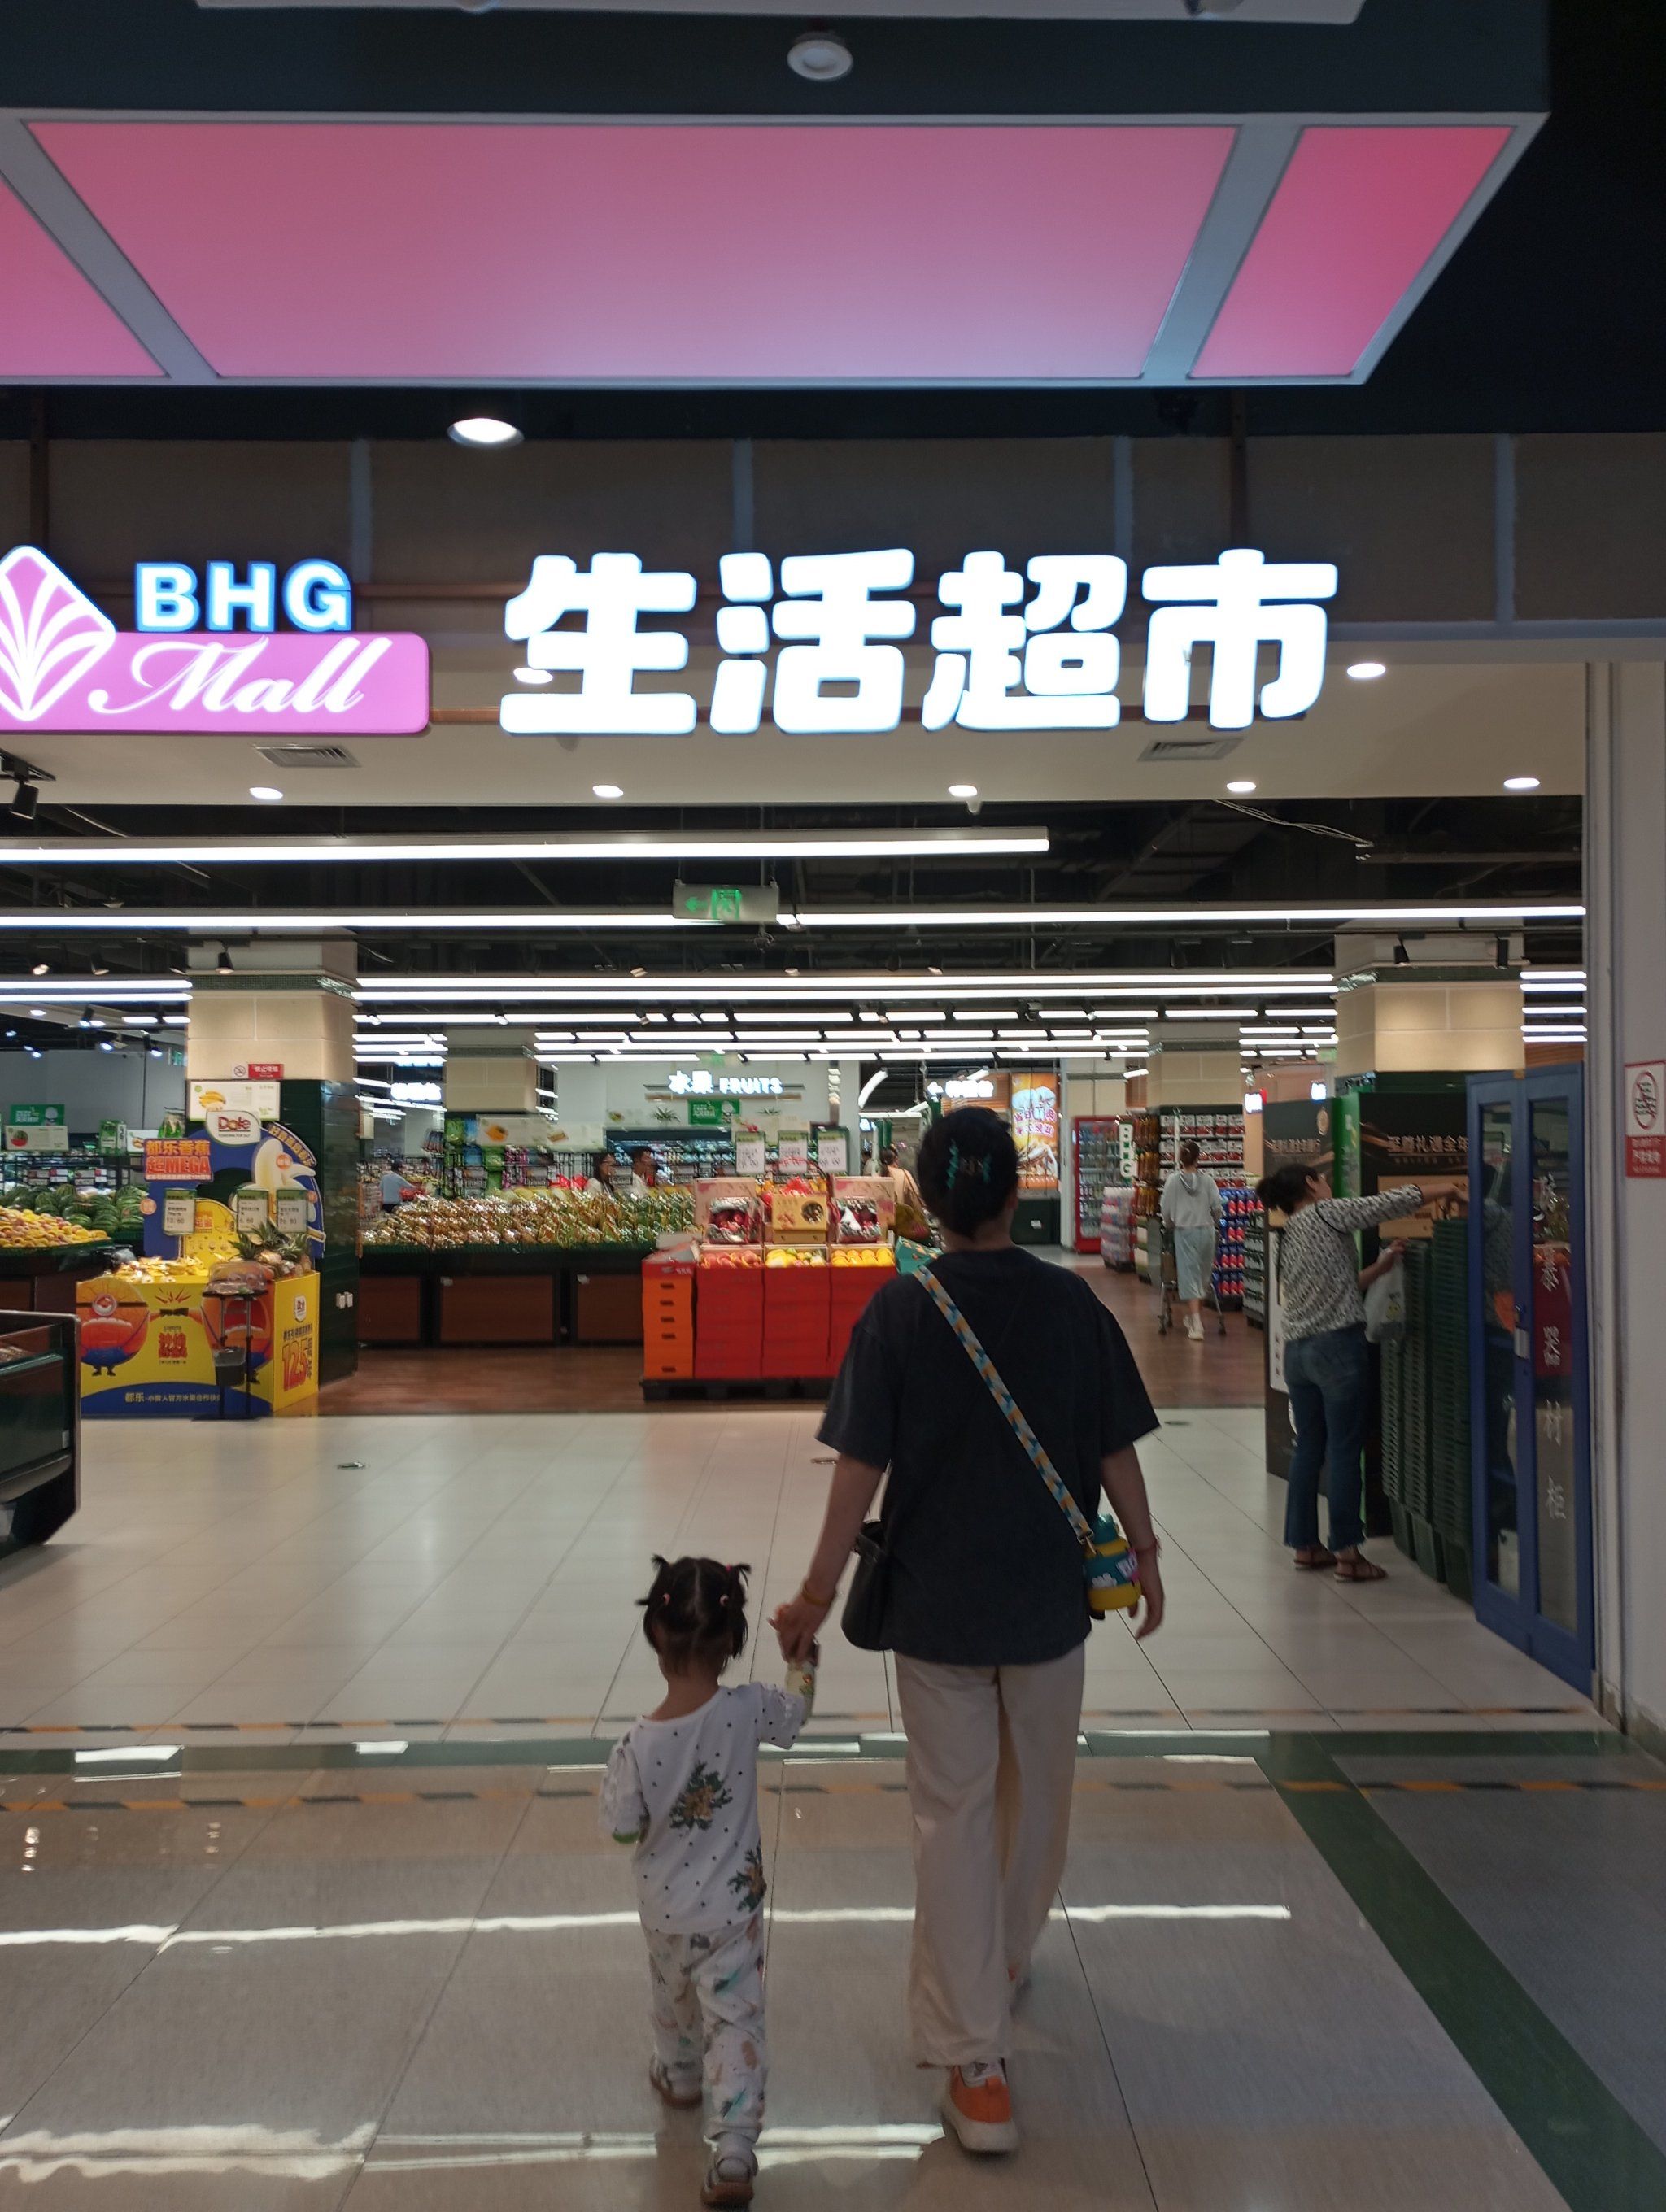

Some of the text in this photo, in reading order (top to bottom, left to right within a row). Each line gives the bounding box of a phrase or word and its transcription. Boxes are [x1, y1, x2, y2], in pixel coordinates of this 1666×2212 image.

[134, 558, 352, 633] BHG
[499, 547, 1338, 734] 生活超市
[89, 634, 393, 716] Mall
[718, 1076, 784, 1095] FRUITS
[217, 1116, 251, 1130] Dole
[146, 1139, 211, 1155] 都乐香蕉
